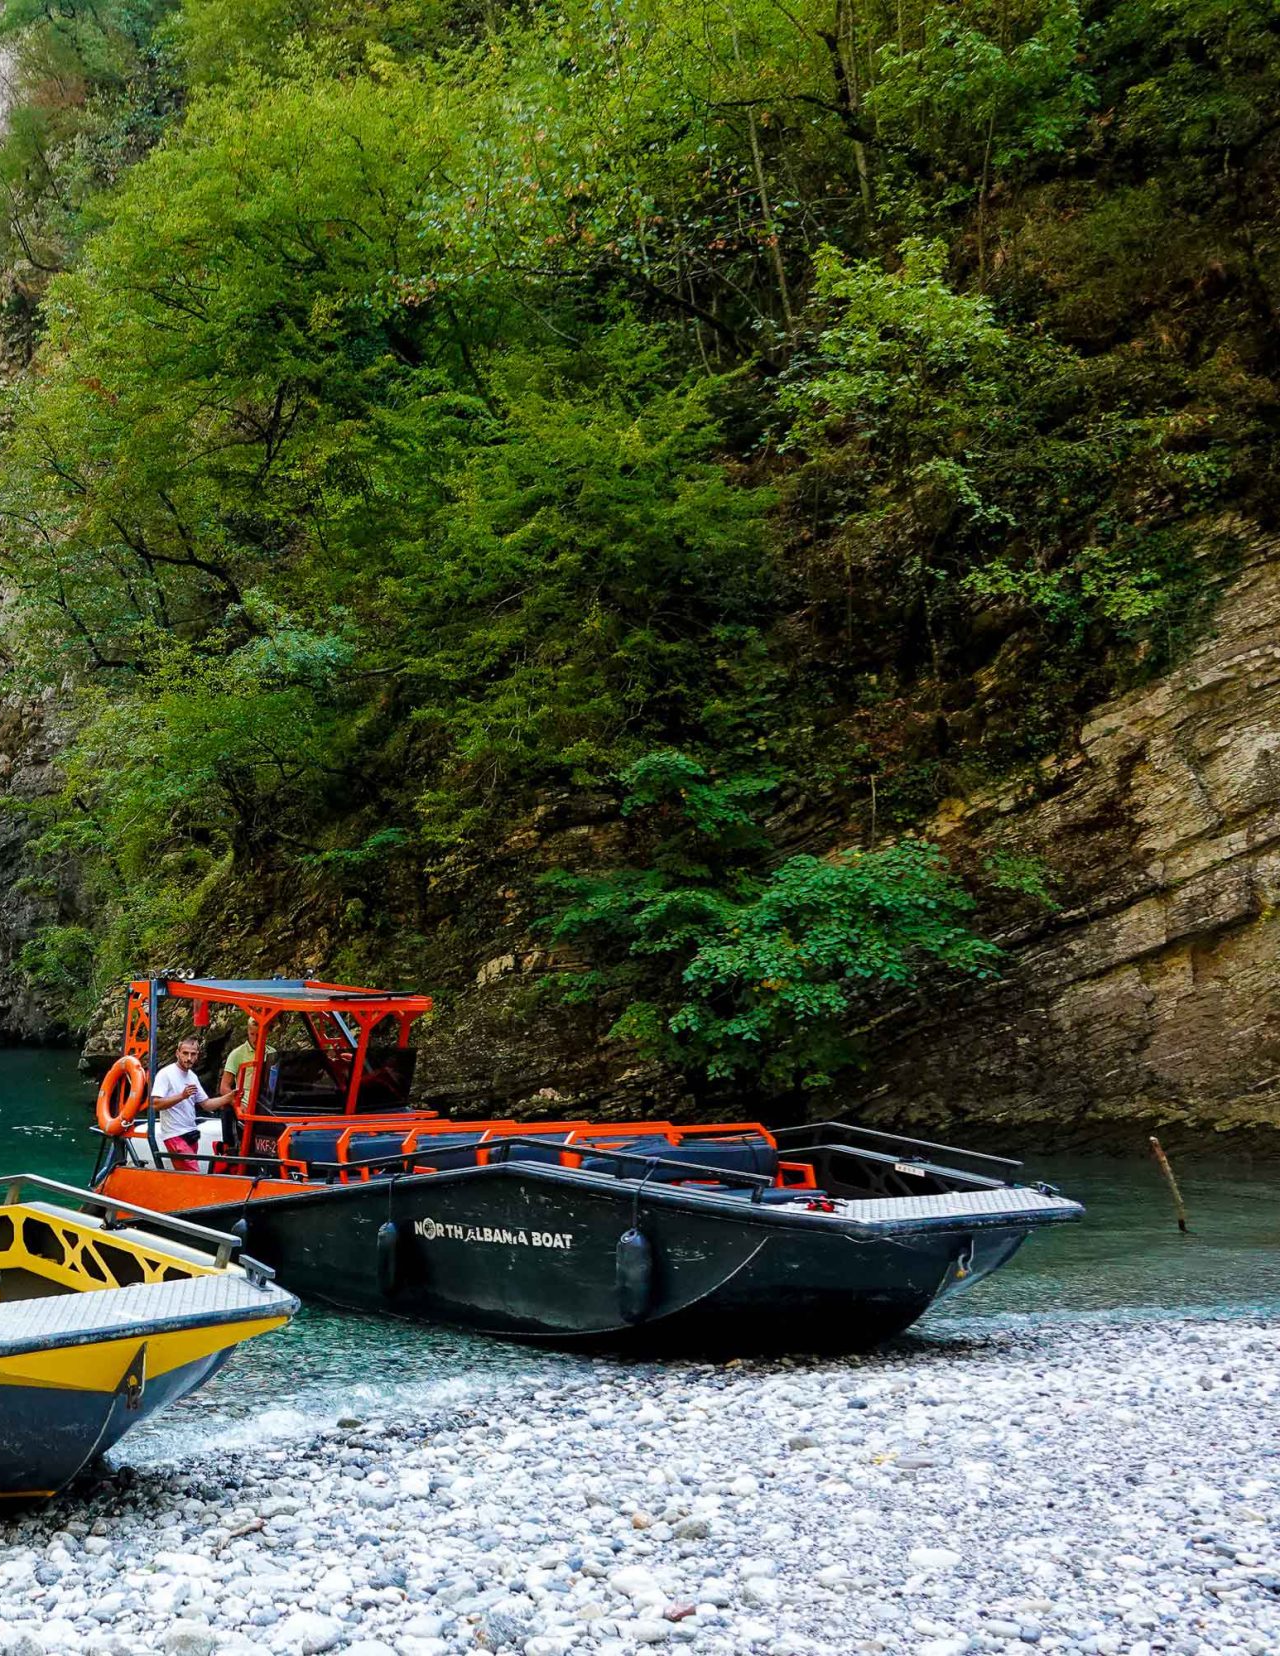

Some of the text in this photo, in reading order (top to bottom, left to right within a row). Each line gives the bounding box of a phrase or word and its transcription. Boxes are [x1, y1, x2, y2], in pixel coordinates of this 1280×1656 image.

[414, 1217, 573, 1249] NORTH ALBANIA BOAT
